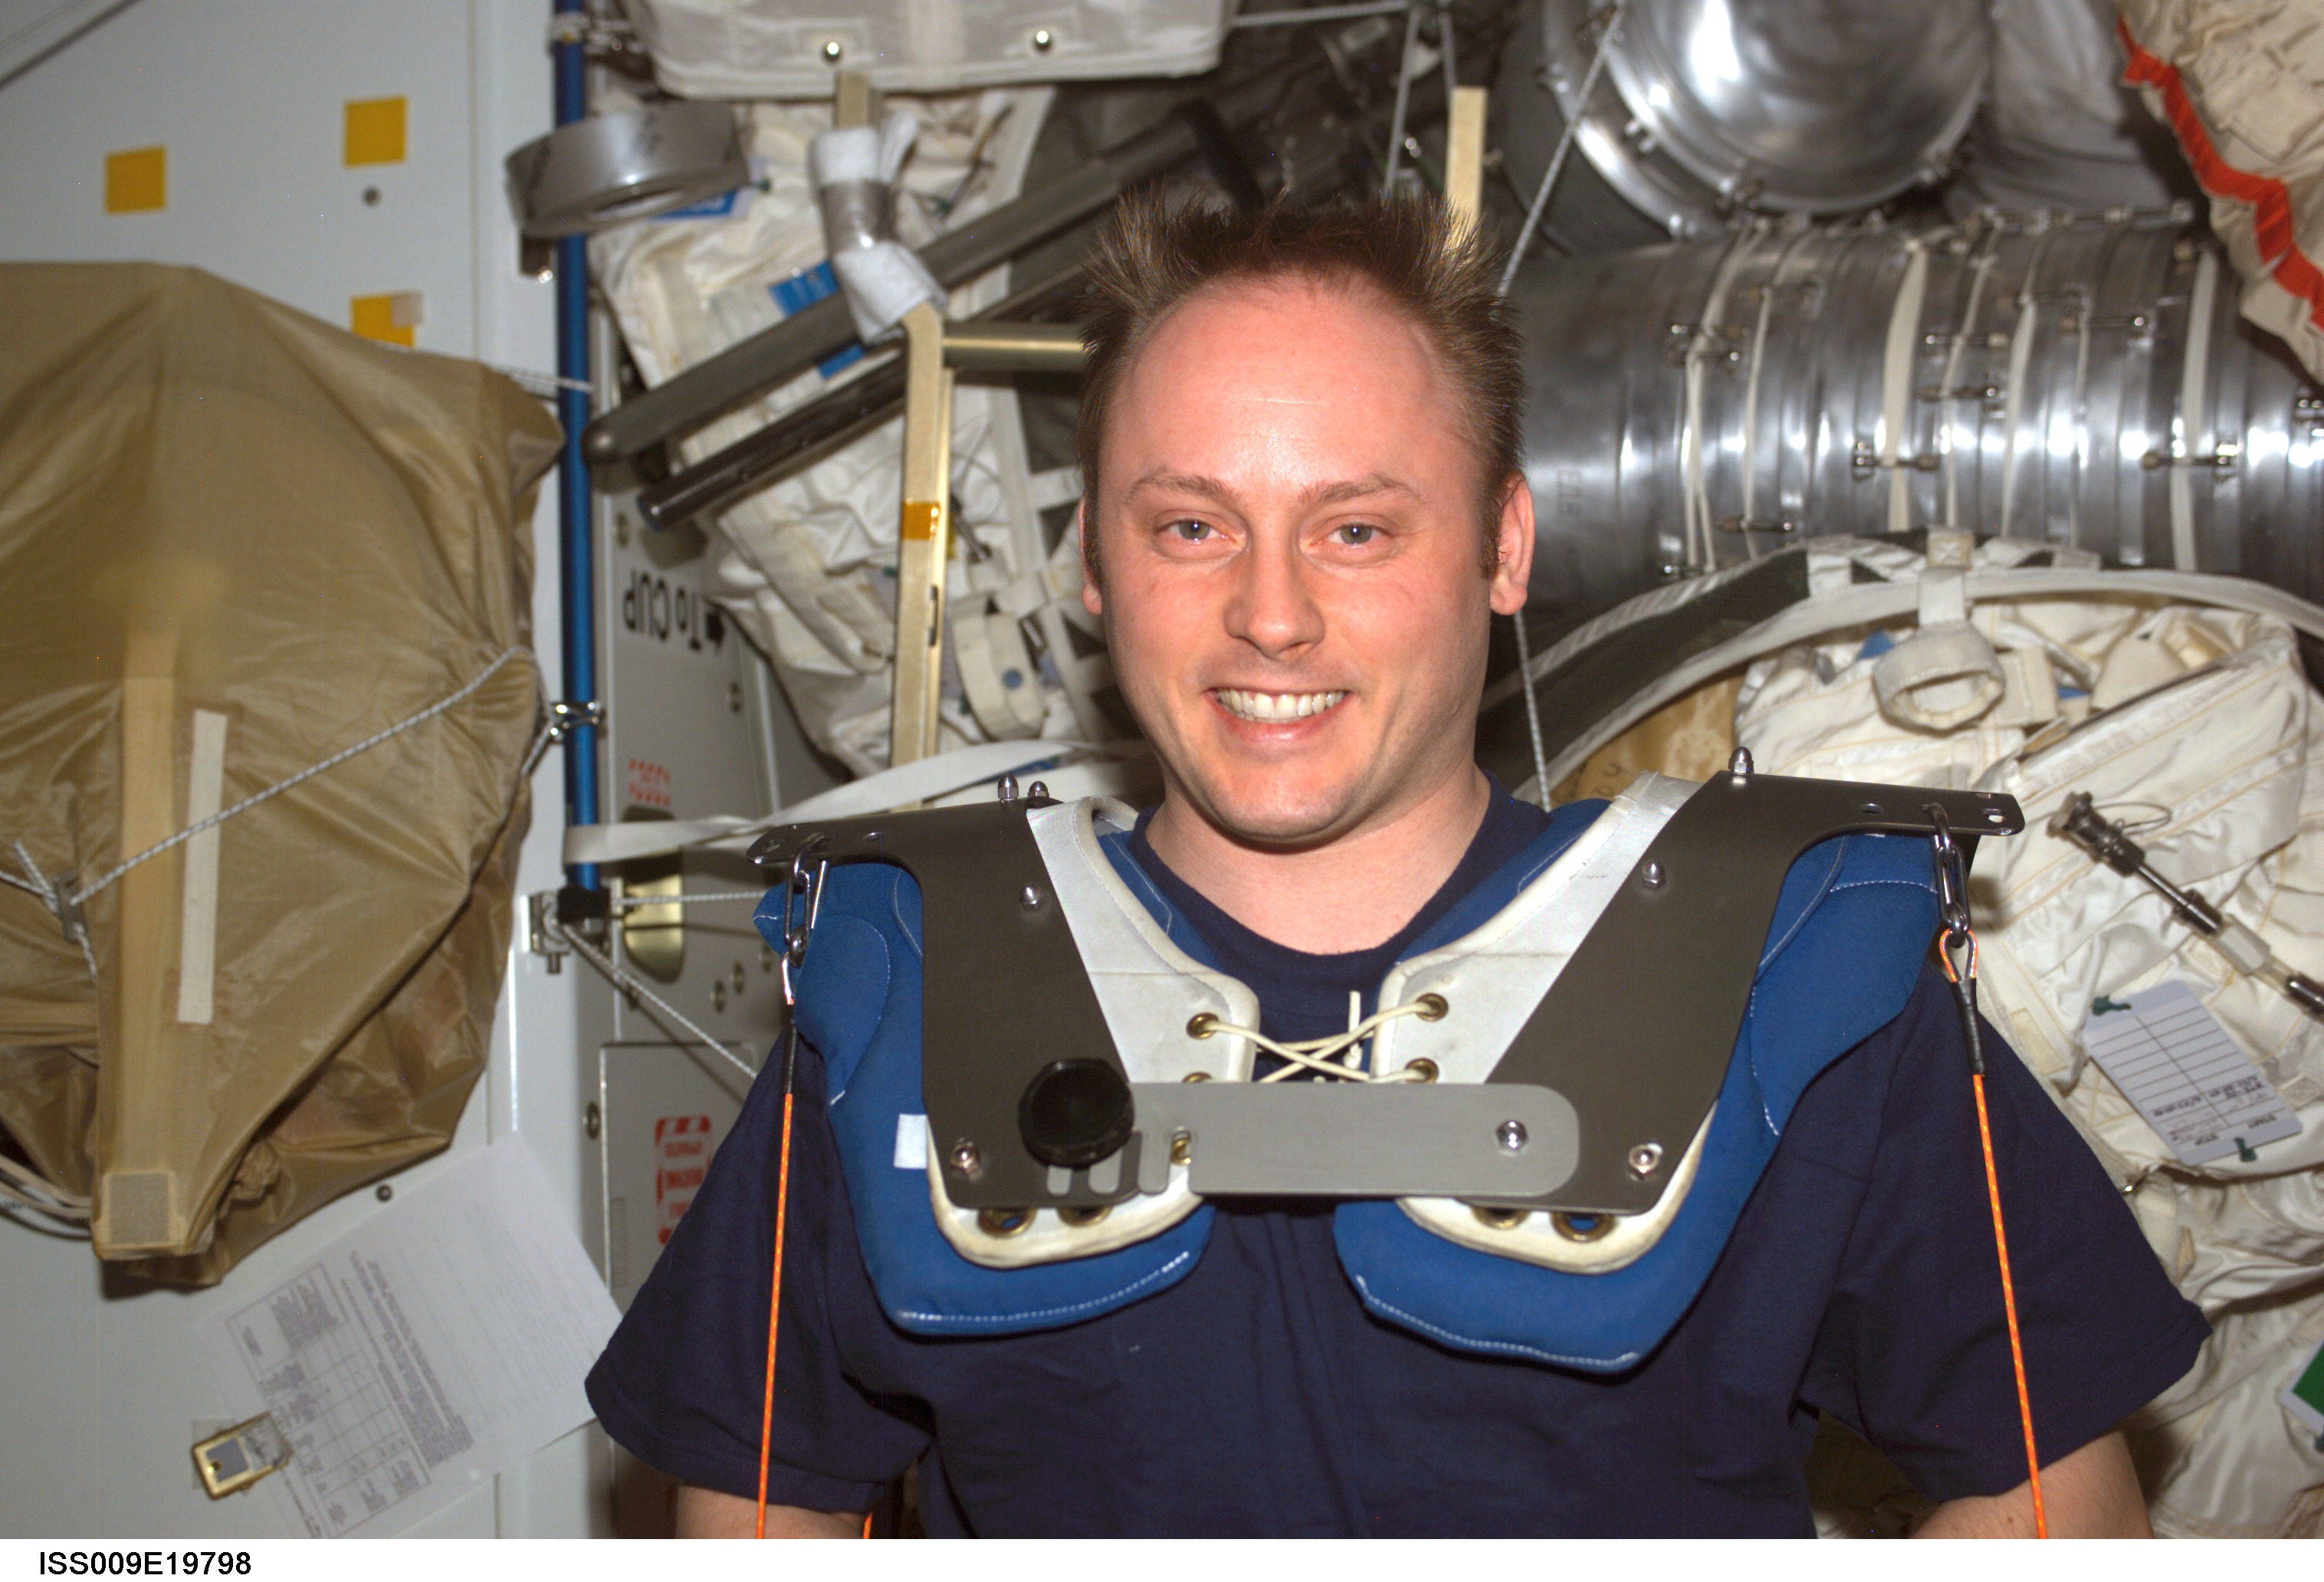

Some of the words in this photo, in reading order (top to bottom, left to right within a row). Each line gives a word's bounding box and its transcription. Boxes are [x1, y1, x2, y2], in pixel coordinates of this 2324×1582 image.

[622, 569, 670, 642] CUP
[674, 587, 702, 652] To
[2247, 1114, 2276, 1129] START
